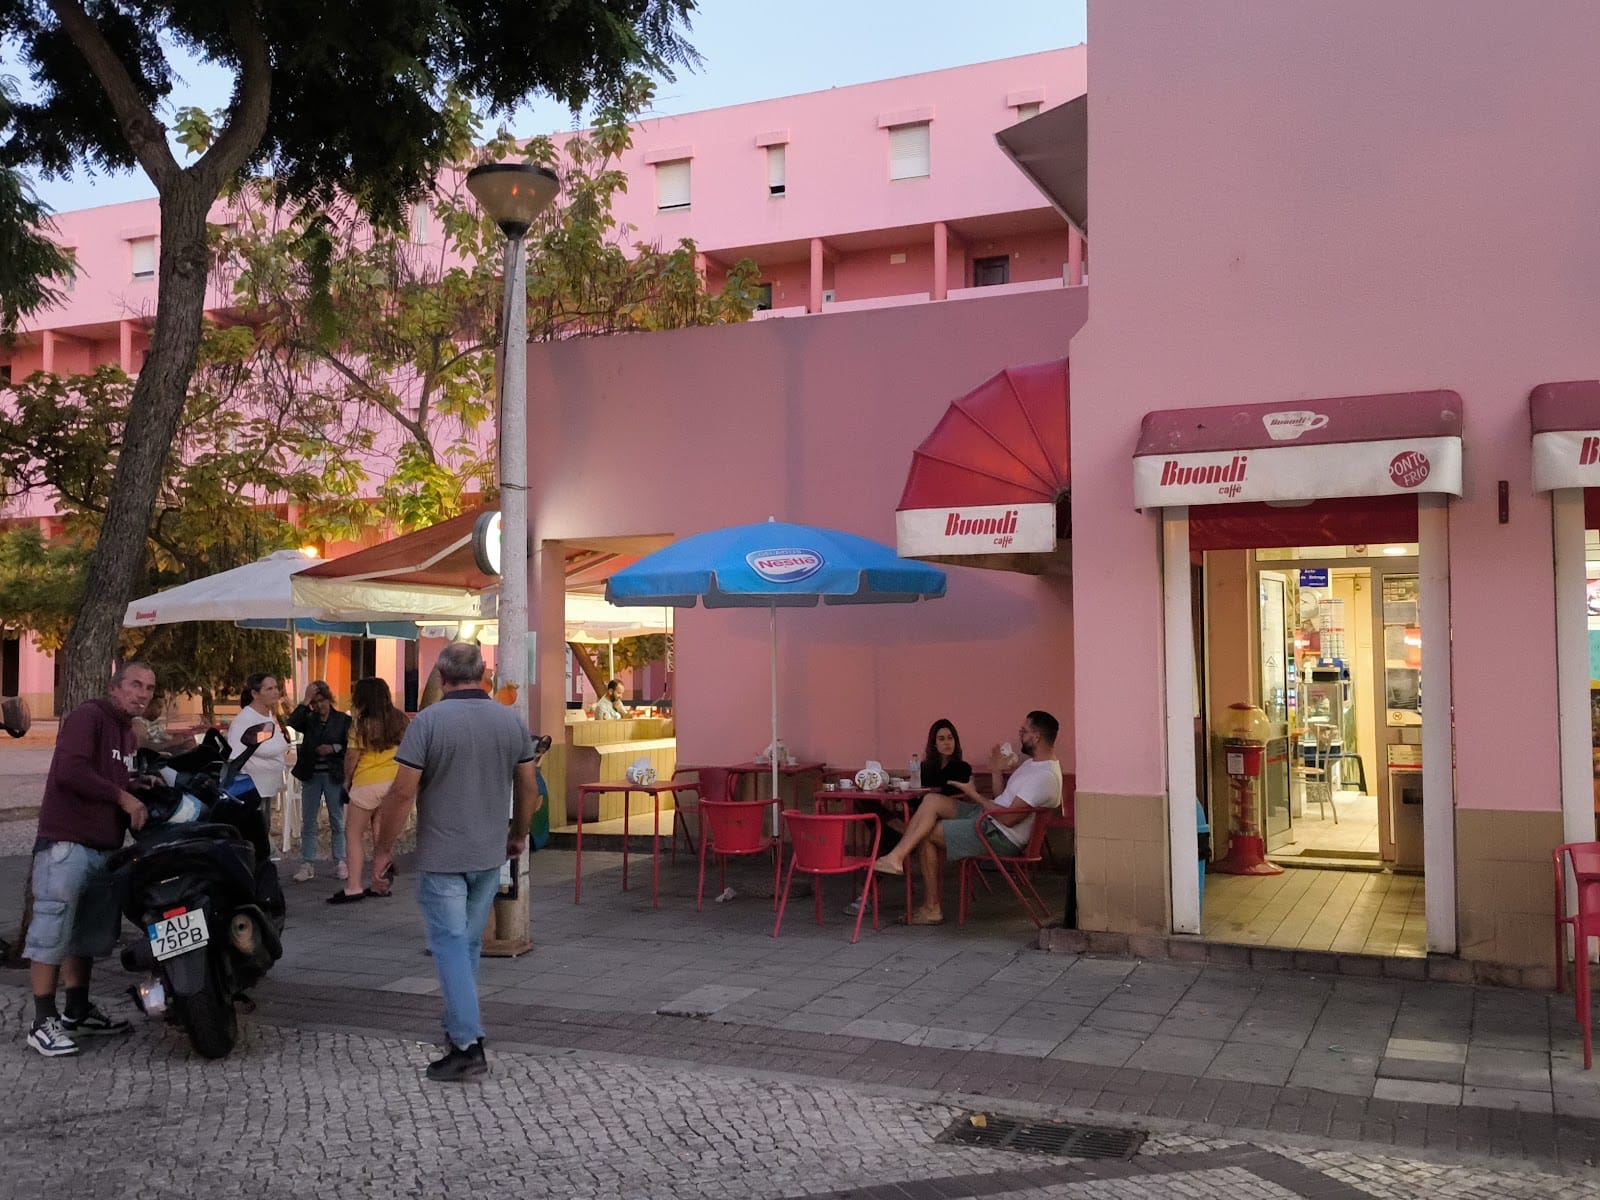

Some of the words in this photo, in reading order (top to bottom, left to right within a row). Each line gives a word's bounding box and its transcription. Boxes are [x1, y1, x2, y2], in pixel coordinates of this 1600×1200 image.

[1579, 436, 1600, 465] B
[1160, 456, 1248, 486] Buondi
[1403, 466, 1428, 486] FRIO
[945, 510, 1019, 536] Buondi
[758, 557, 816, 569] Nestlé
[165, 915, 190, 936] AU
[156, 927, 202, 953] 75PB
